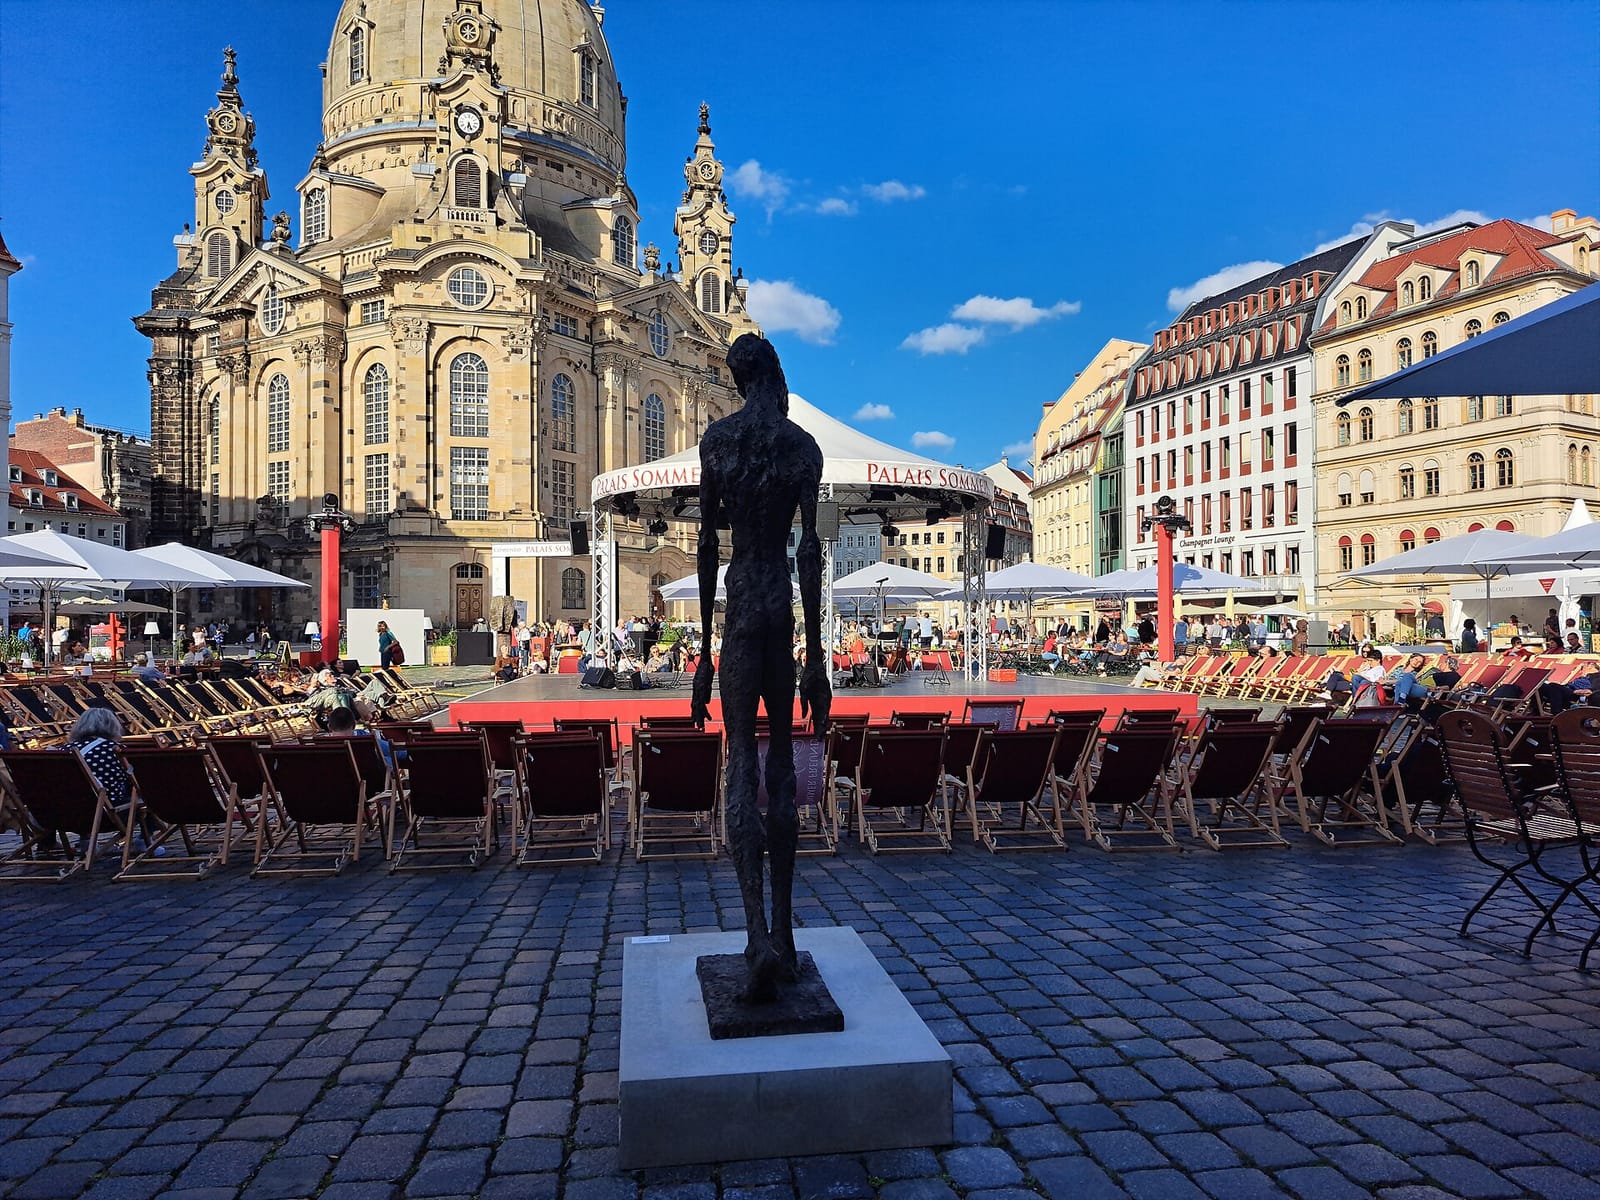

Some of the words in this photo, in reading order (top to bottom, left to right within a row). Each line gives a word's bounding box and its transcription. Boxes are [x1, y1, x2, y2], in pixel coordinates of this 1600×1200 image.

[633, 467, 700, 487] SOMME
[867, 463, 932, 485] PALAIS
[525, 545, 553, 553] PALAIS
[1179, 538, 1213, 549] Champagner
[1214, 535, 1236, 545] Lounge
